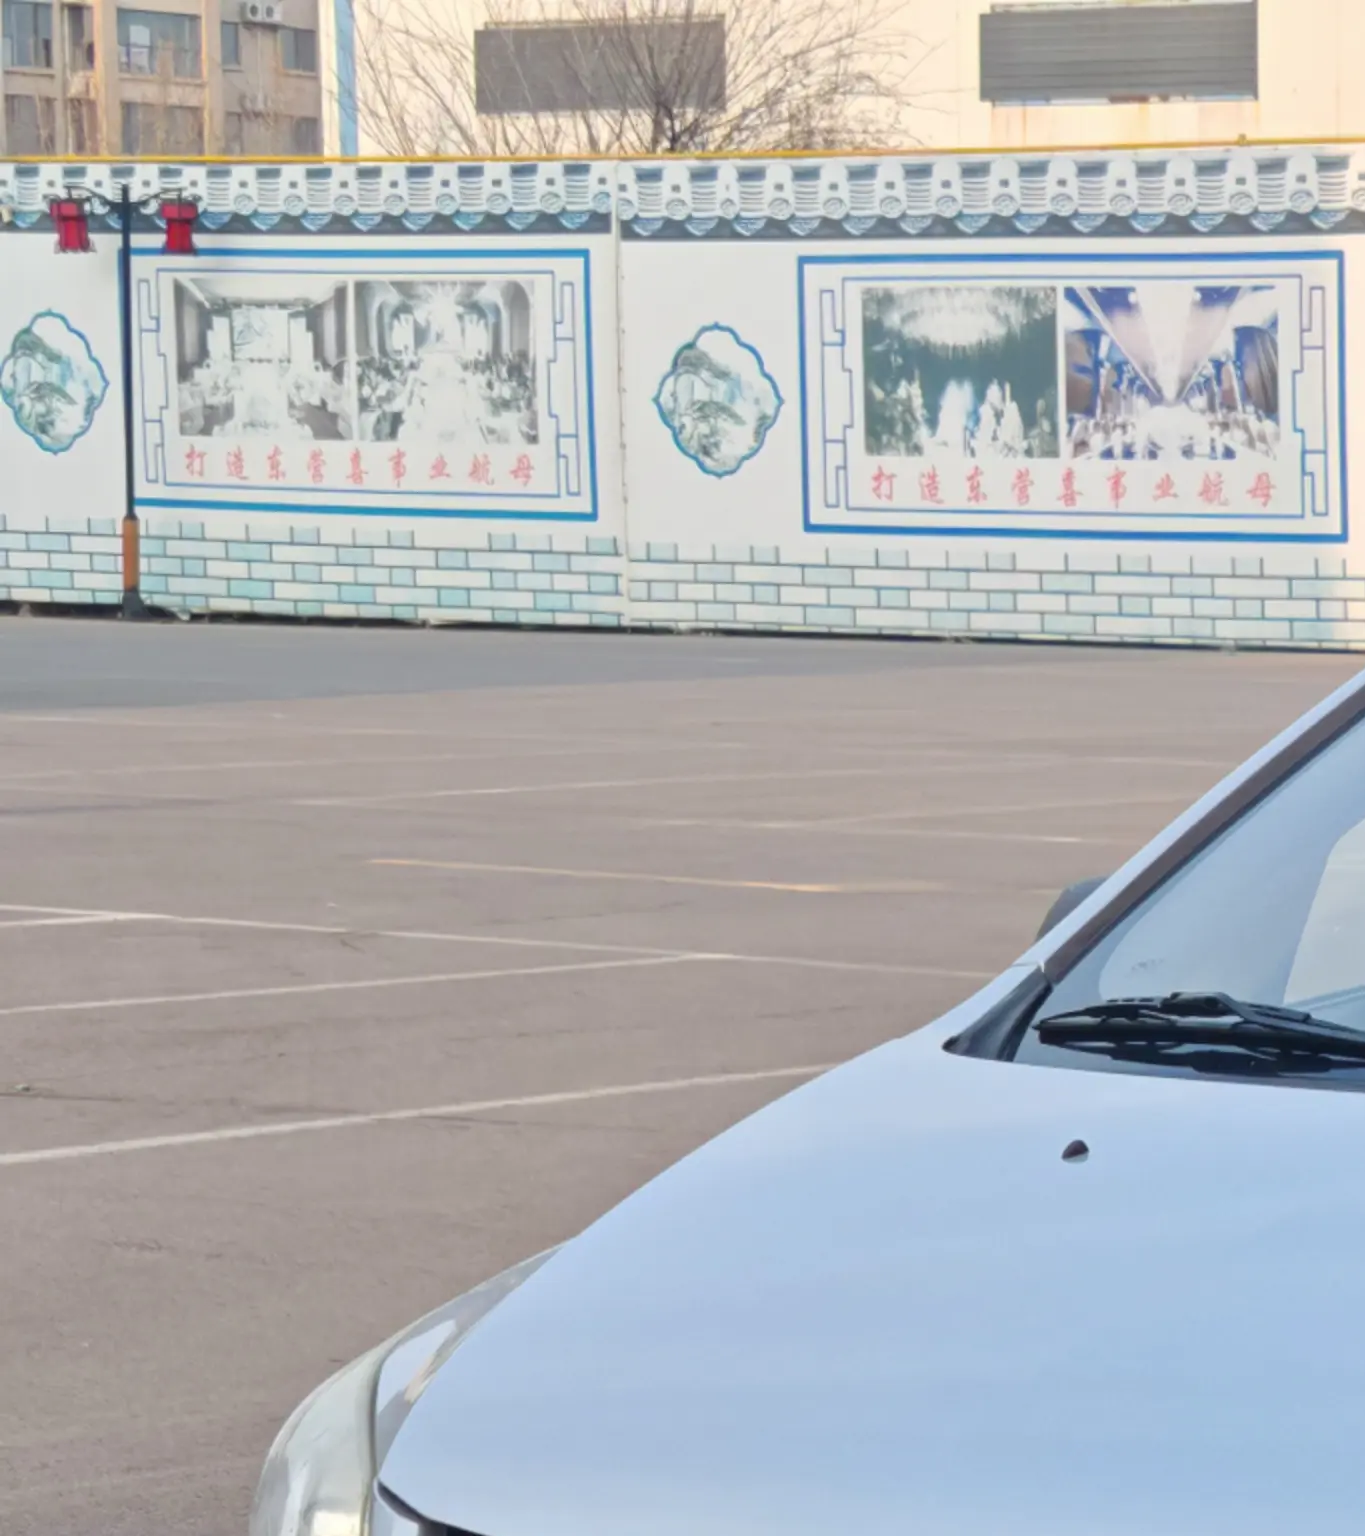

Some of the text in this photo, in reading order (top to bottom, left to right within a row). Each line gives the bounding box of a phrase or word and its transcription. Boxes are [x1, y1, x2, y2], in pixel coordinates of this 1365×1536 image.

[184, 445, 537, 488] 打造东营喜事业航母
[870, 465, 1278, 510] 打造东营喜事业航母
